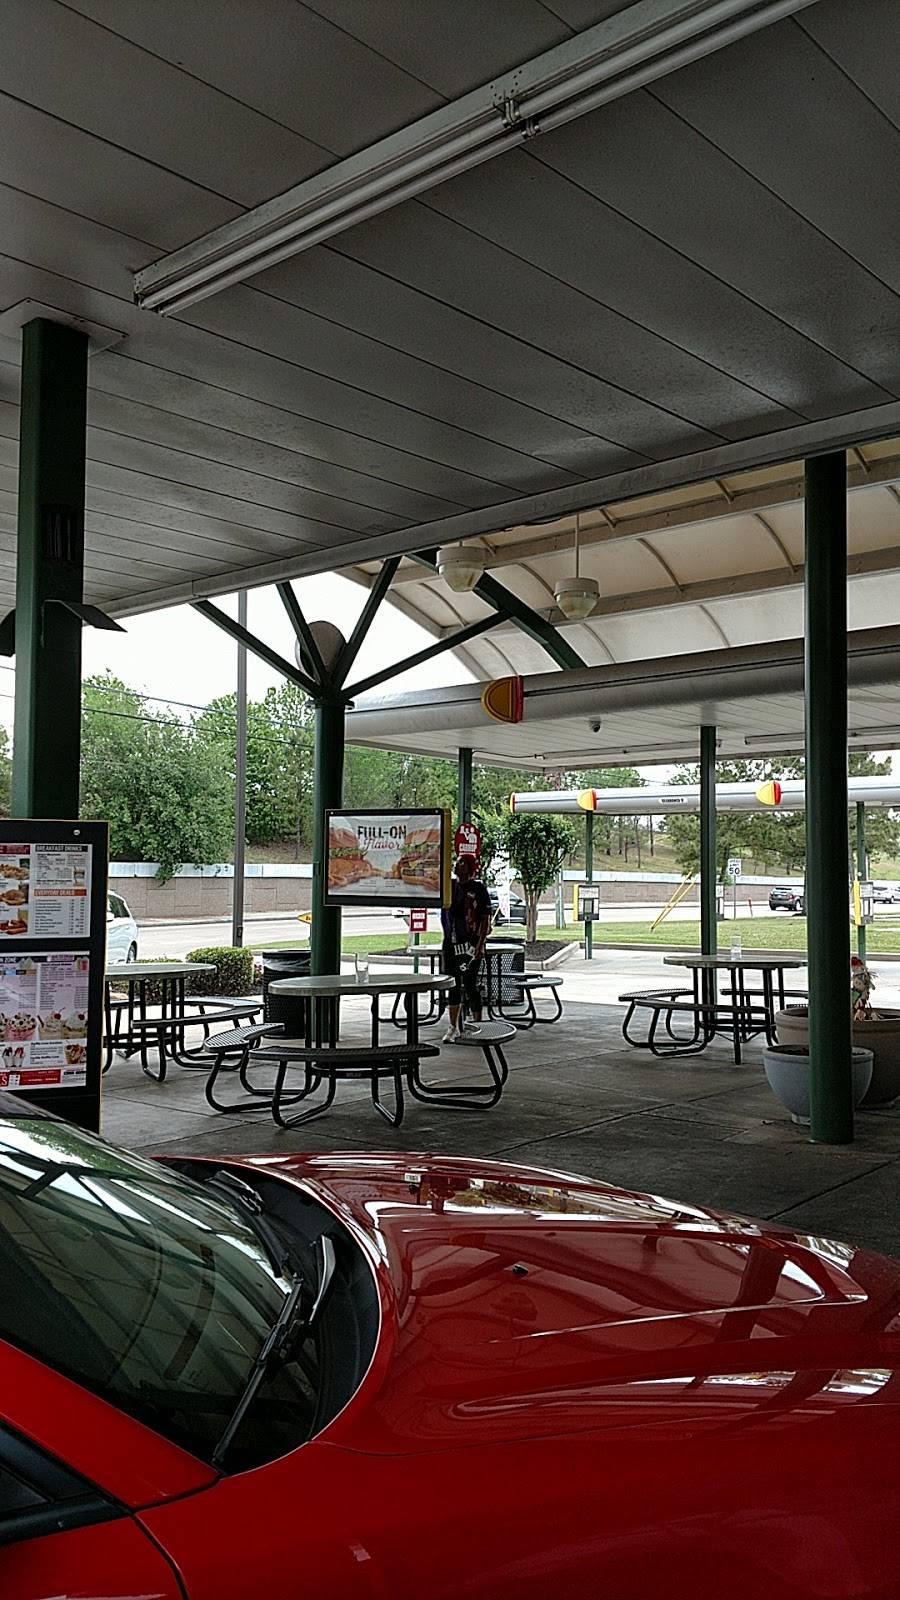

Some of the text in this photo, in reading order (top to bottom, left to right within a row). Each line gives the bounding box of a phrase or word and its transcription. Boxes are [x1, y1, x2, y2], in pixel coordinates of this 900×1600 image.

[357, 825, 407, 839] FULL-ON
[362, 838, 402, 850] Flavor
[729, 867, 741, 875] 50
